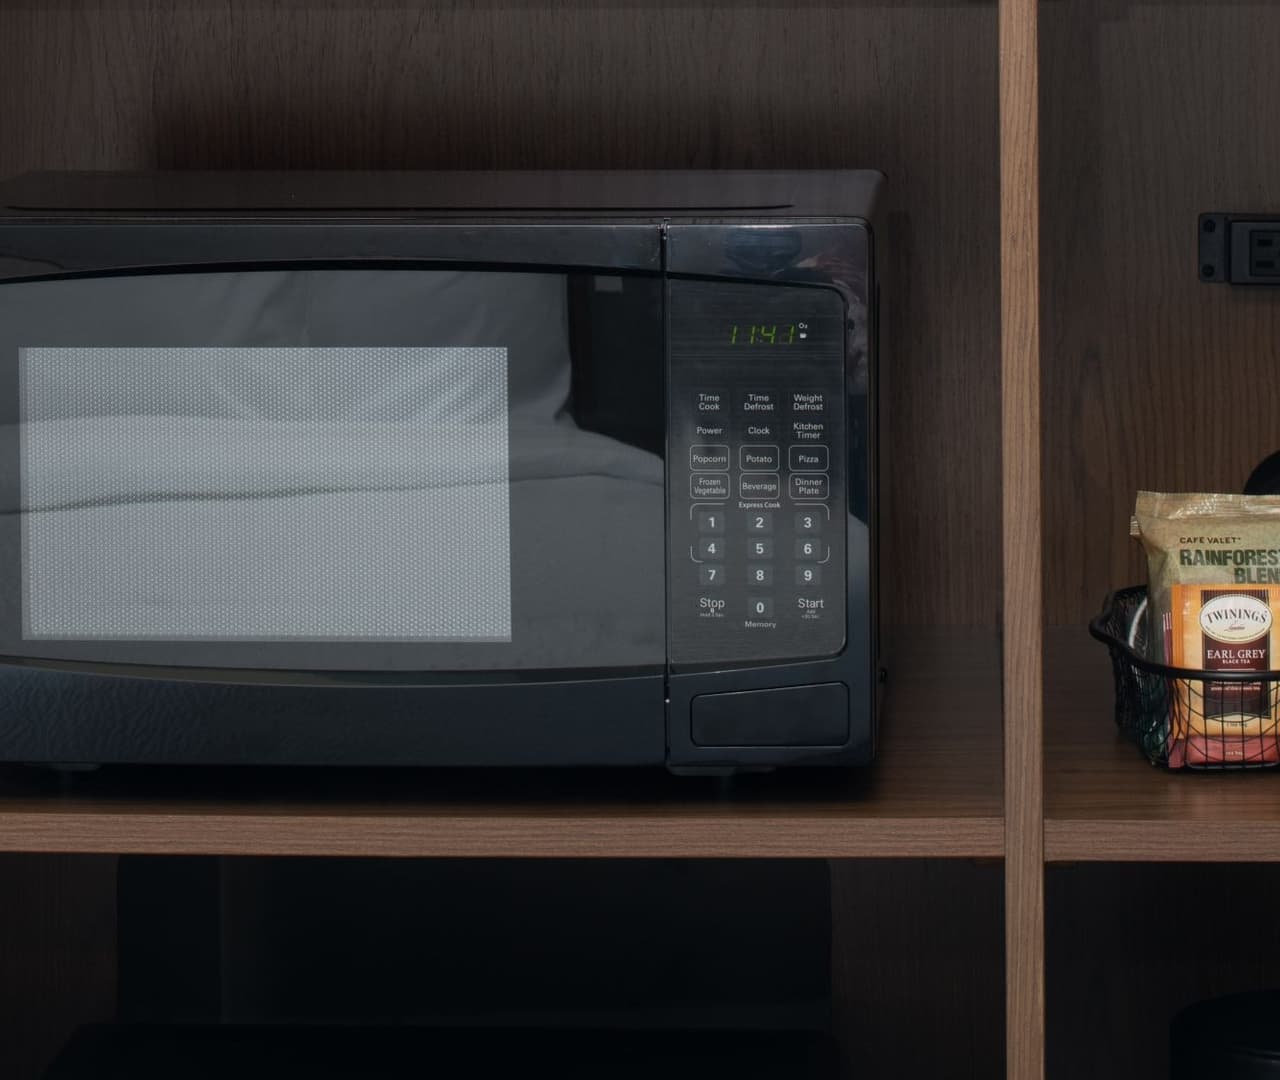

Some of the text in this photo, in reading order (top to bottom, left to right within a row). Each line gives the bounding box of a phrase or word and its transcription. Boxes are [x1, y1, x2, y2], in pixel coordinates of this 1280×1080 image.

[793, 394, 823, 403] Weight
[744, 402, 774, 410] Defrost
[696, 427, 722, 435] Power
[797, 431, 821, 439] Timer
[692, 455, 727, 464] Popcorn
[746, 455, 772, 463] Potato
[798, 455, 819, 463] Pizza
[742, 482, 777, 491] Beverage
[795, 478, 823, 486] Dinner
[694, 487, 726, 495] Vegetable
[798, 487, 819, 495] Plate
[708, 517, 716, 528] 1
[755, 517, 764, 528] 2
[803, 517, 812, 528] 3
[707, 544, 716, 554] 4
[755, 544, 764, 554] 5
[803, 544, 812, 554] 6
[708, 570, 716, 580] 7
[755, 570, 764, 581] 8
[803, 570, 812, 581] 9
[699, 598, 725, 610] Stop
[756, 603, 764, 613] 0
[798, 598, 824, 609] Start
[1206, 607, 1266, 624] TWININGS
[744, 621, 777, 629] Memory
[1207, 649, 1266, 659] EARL GREY
